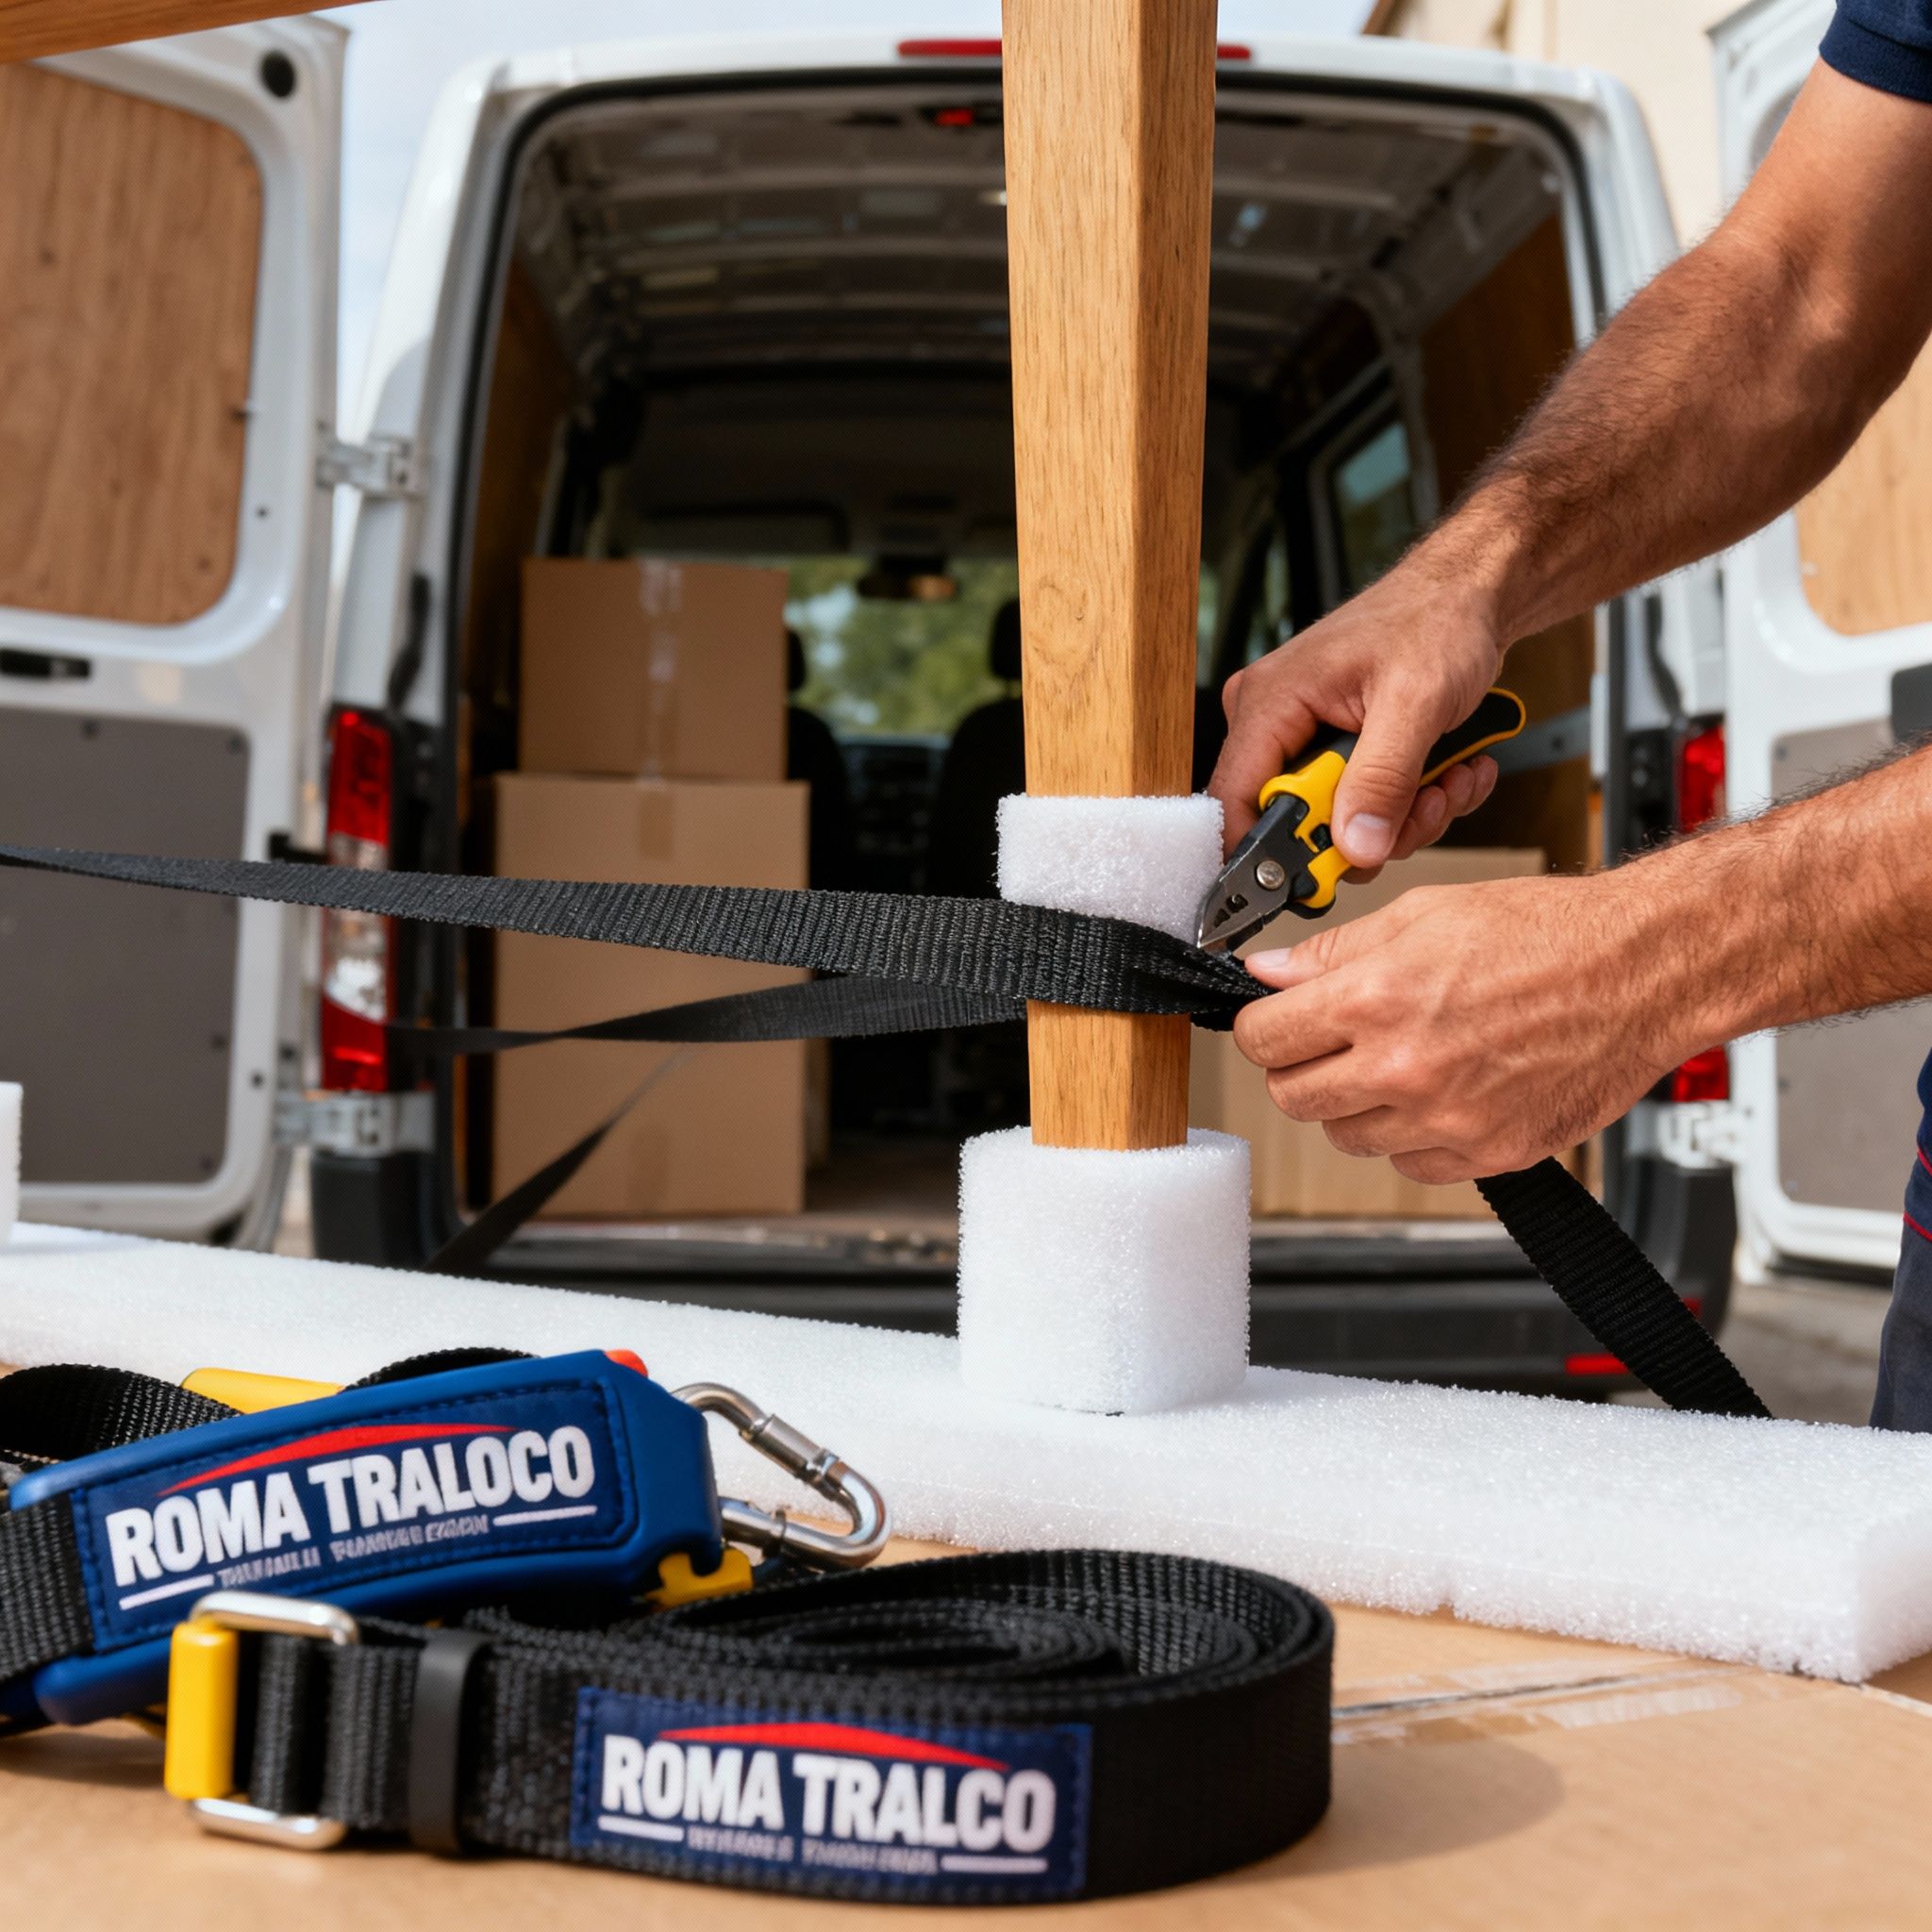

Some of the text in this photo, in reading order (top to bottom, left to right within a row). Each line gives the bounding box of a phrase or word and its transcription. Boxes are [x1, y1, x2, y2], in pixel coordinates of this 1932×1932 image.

[105, 1471, 311, 1588] ROMA
[308, 1425, 595, 1534] TRALOCO
[601, 1734, 786, 1831] ROMA
[792, 1753, 1057, 1853] TRALCO
